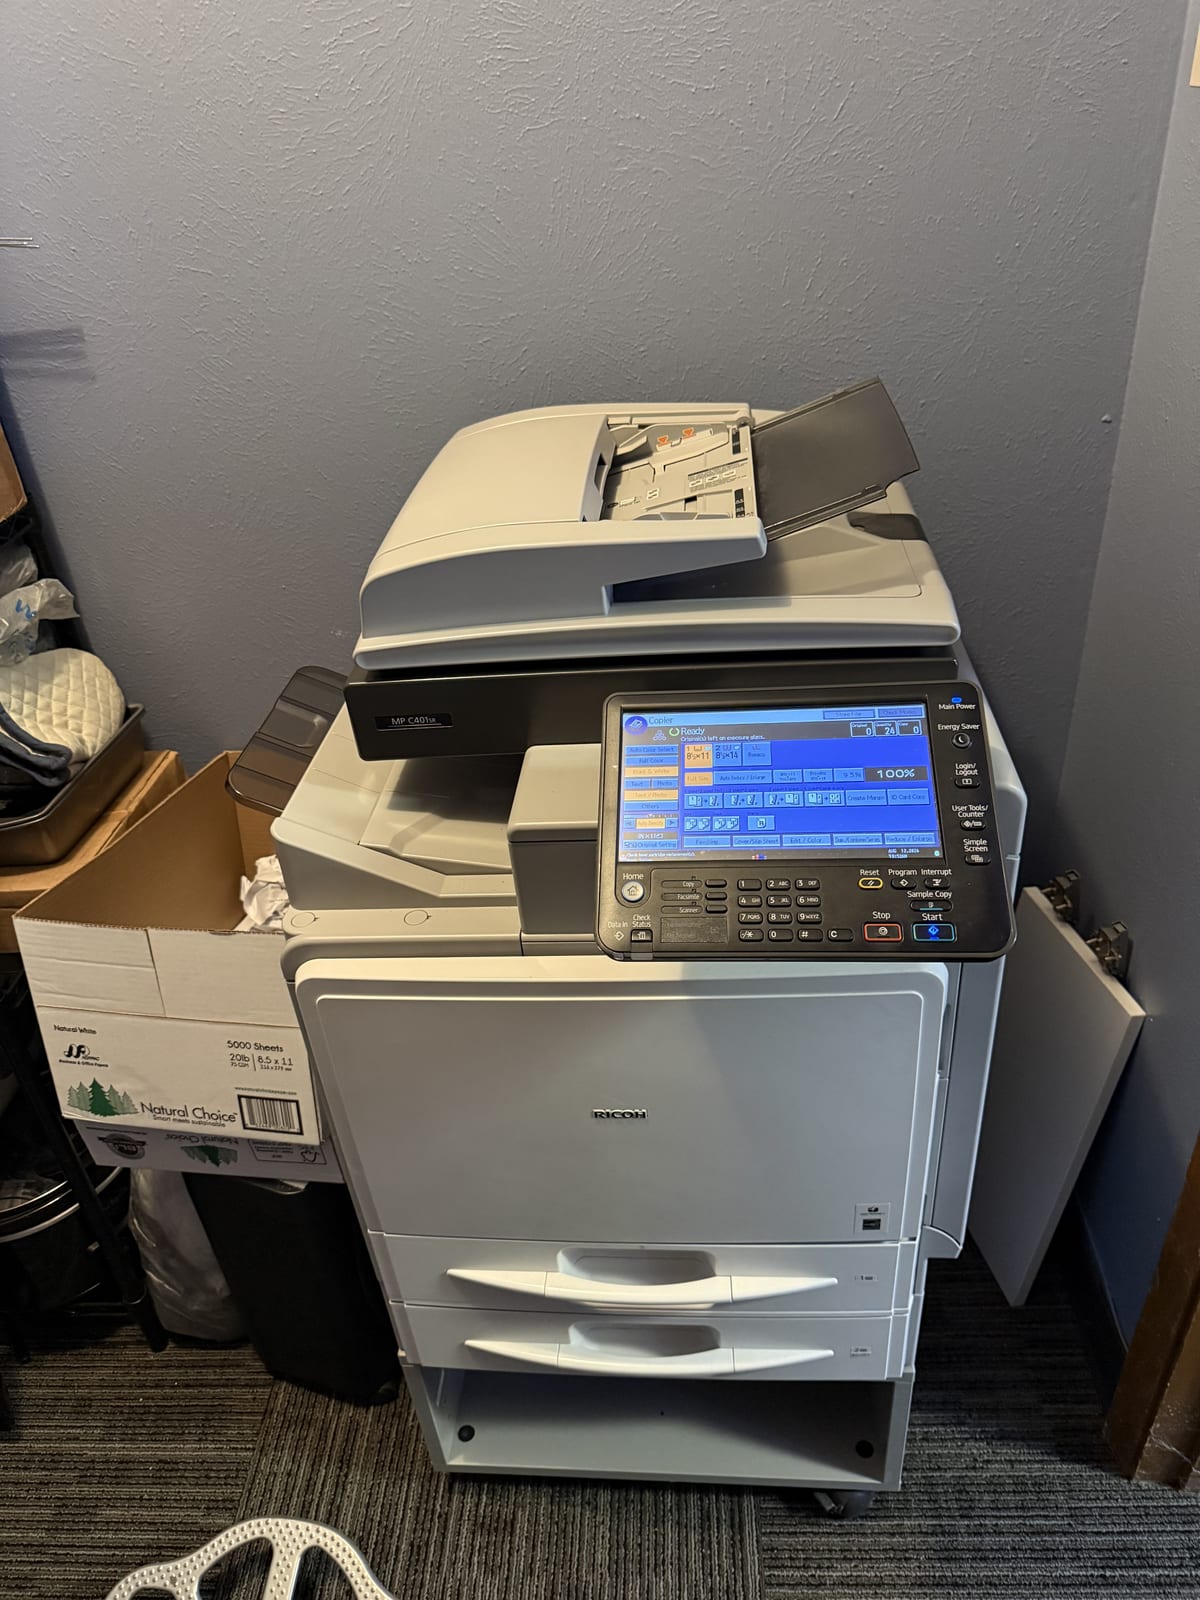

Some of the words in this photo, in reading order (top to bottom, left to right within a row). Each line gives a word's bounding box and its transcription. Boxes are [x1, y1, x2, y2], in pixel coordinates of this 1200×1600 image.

[391, 717, 406, 725] MP
[648, 716, 673, 726] Copier
[681, 727, 705, 737] Ready
[866, 727, 872, 735] 0
[885, 727, 895, 735] 24
[913, 726, 919, 734] 0
[876, 768, 915, 778] 100%
[963, 838, 988, 846] Simple
[888, 869, 917, 877] Program
[921, 868, 952, 876] Interrupt
[907, 891, 934, 899] Sample
[935, 891, 952, 899] Copy
[872, 911, 891, 920] Stop
[53, 1024, 78, 1033] Natural
[227, 1040, 252, 1050] 5000
[253, 1042, 284, 1052] Sheets
[229, 1053, 250, 1062] 20lb
[257, 1055, 272, 1064] 8.5
[282, 1057, 294, 1066] 11
[140, 1102, 189, 1118] Natural
[592, 1109, 648, 1119] RICOH
